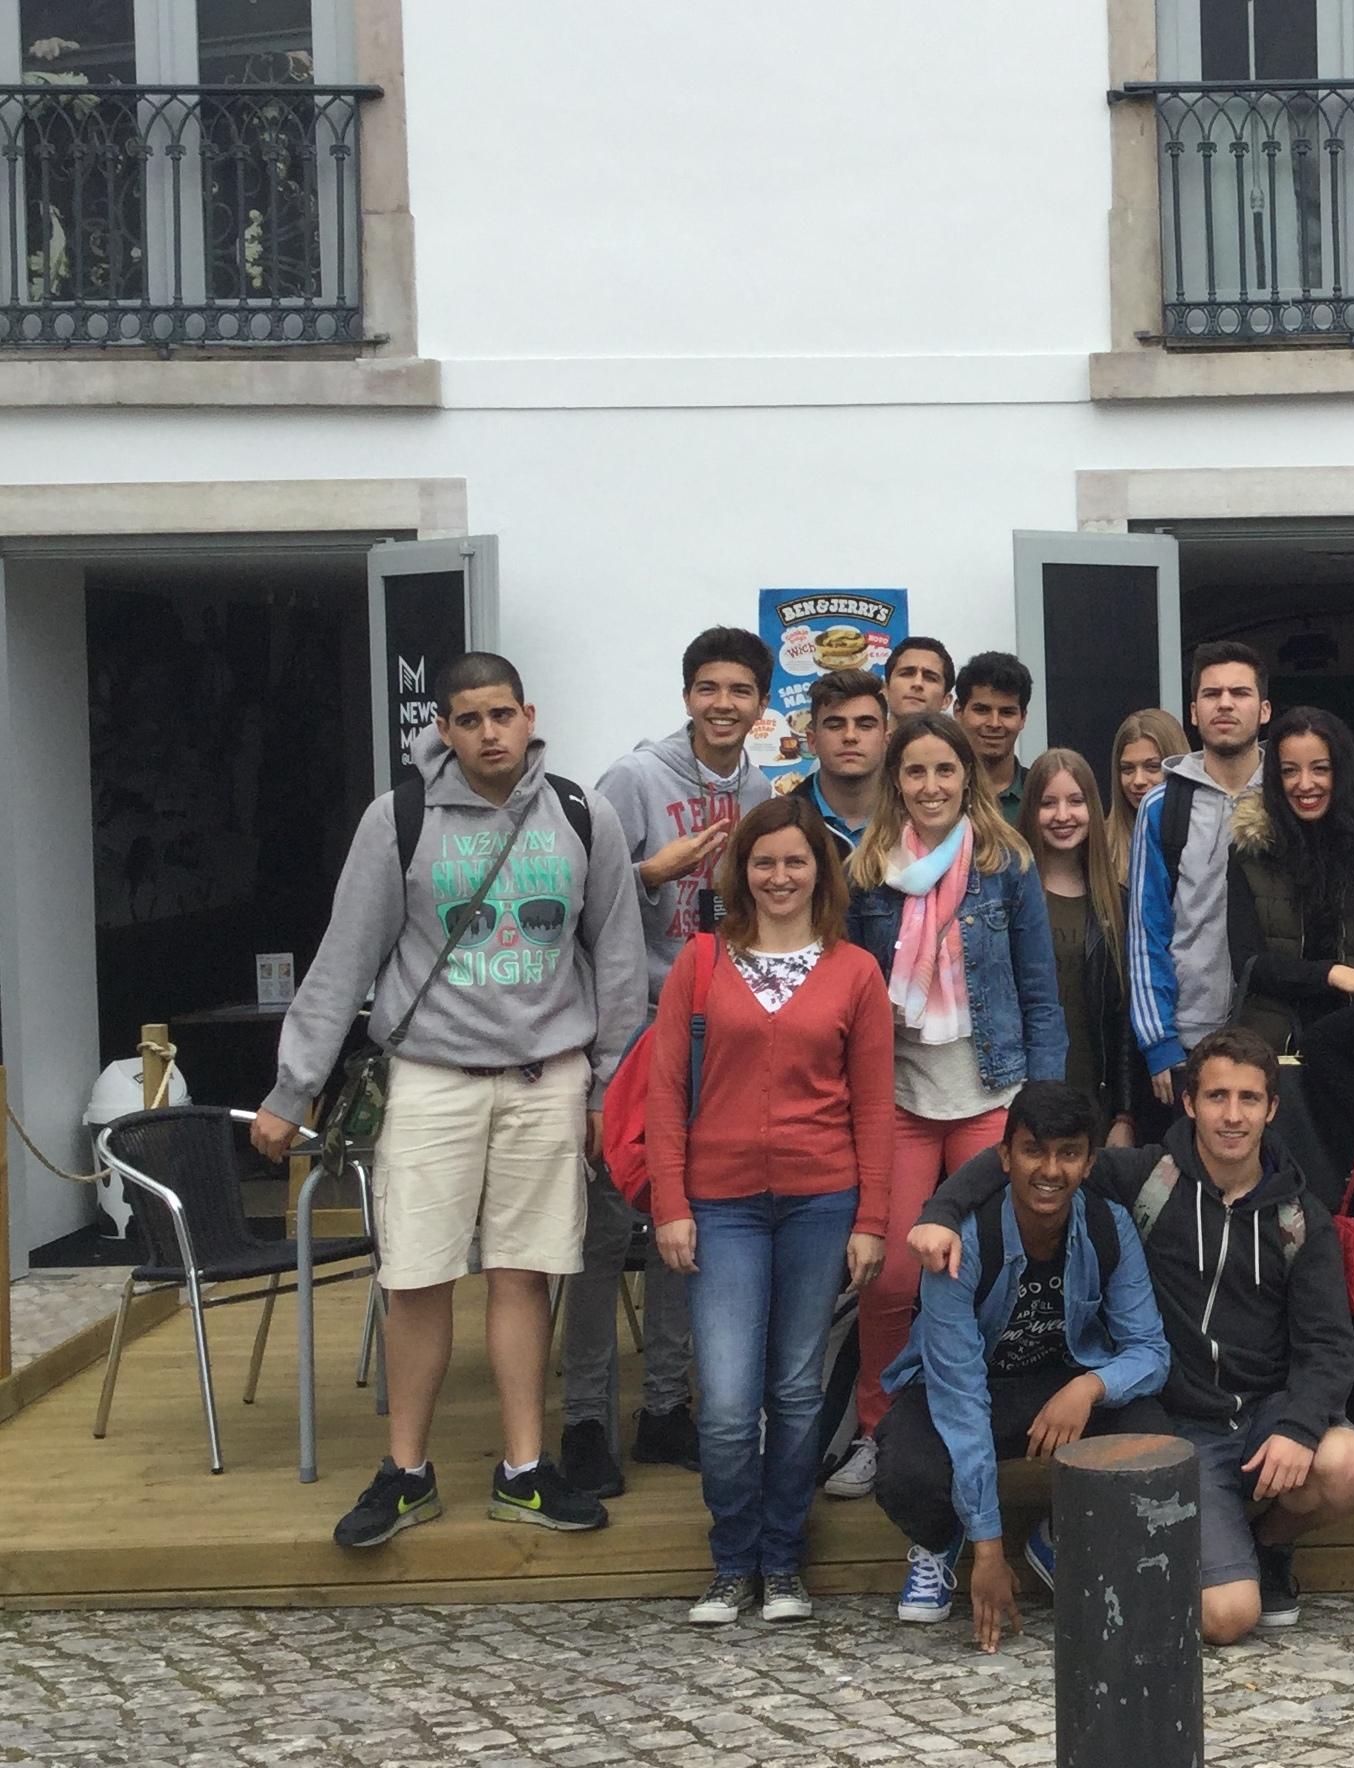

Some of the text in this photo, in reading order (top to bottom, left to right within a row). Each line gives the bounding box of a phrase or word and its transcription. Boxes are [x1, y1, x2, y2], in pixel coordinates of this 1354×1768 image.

[400, 701, 438, 724] NEWS
[442, 834, 448, 858] I
[676, 880, 699, 905] 77
[447, 948, 561, 987] NIGHT
